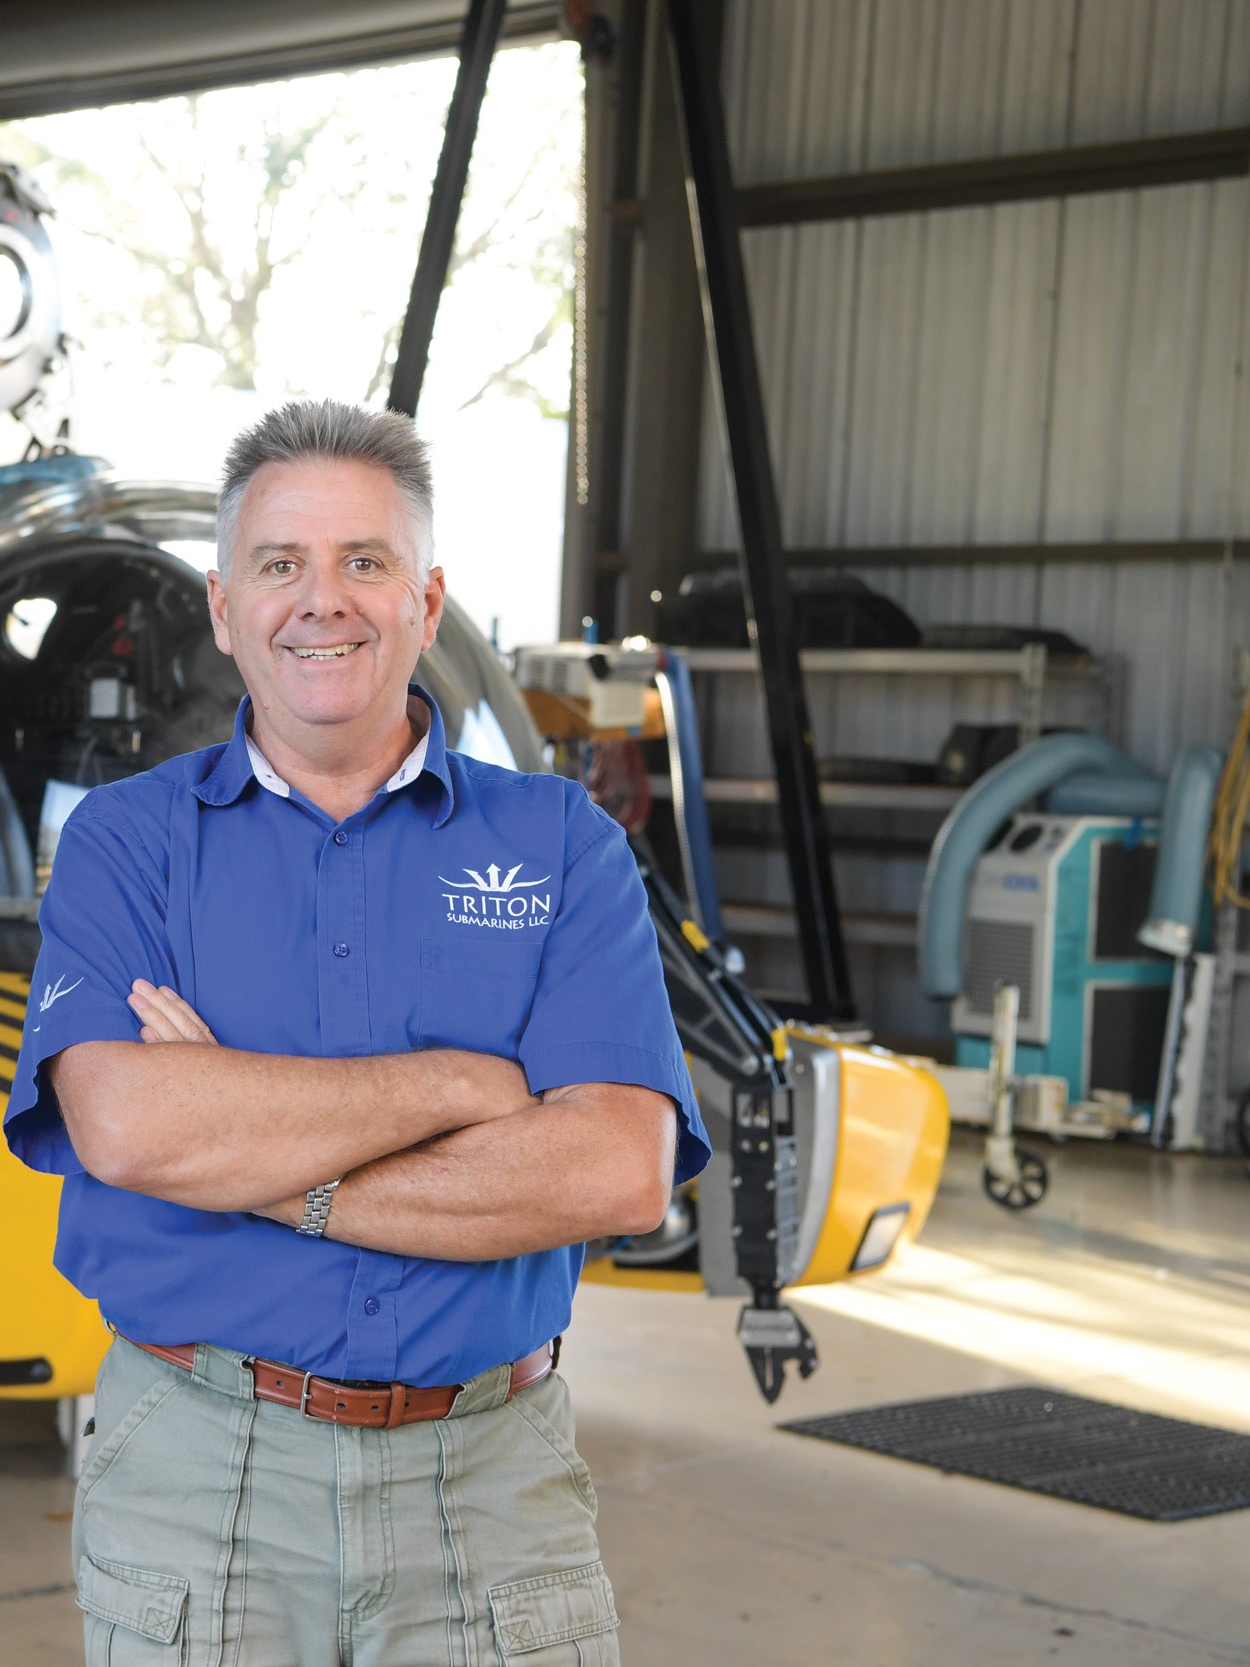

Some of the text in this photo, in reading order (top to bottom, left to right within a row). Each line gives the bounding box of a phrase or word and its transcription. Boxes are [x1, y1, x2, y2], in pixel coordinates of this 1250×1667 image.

[442, 894, 551, 917] TRITON
[446, 912, 550, 930] SUBMARINES LLC
